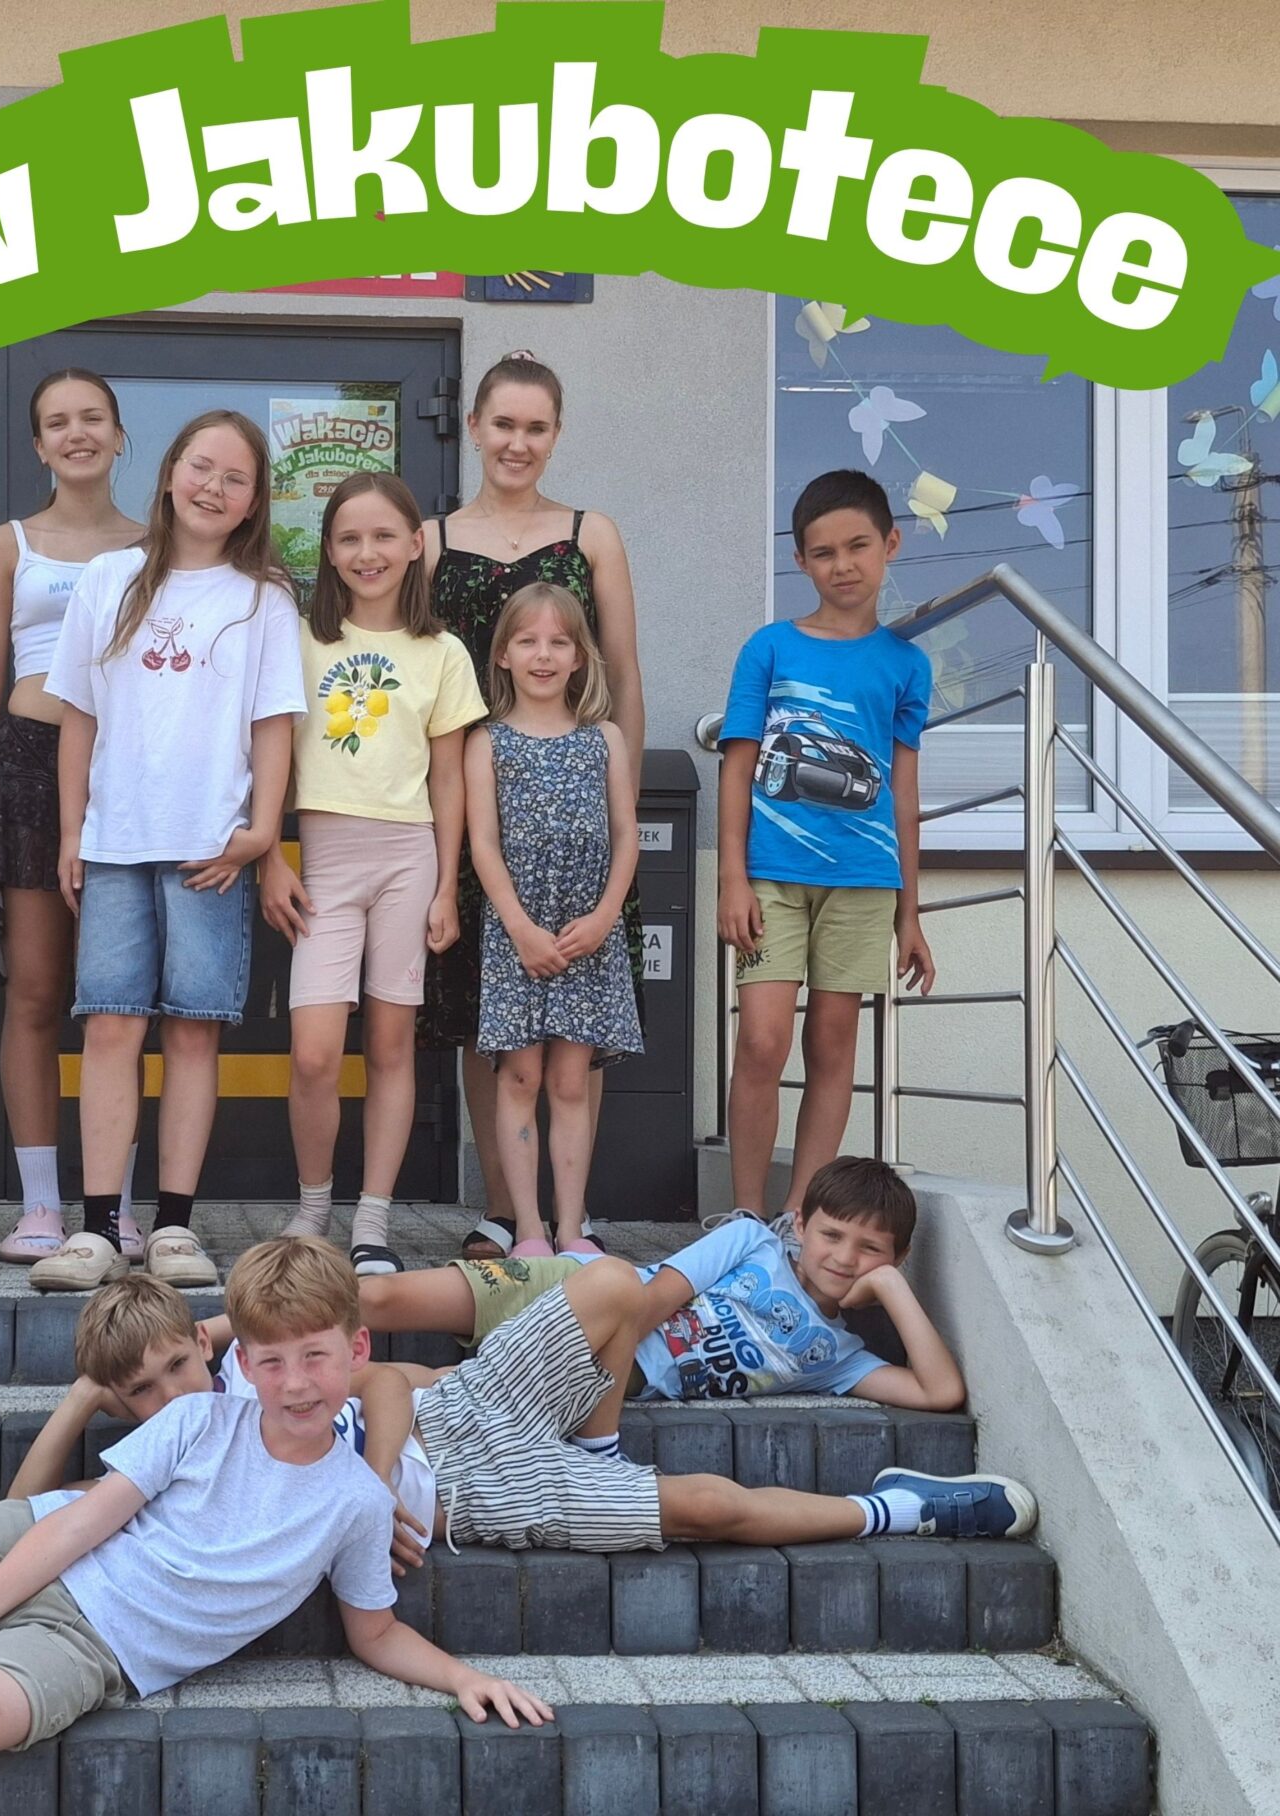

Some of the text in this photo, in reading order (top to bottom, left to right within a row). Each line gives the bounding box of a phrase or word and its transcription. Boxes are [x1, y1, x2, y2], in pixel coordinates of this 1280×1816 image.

[274, 415, 391, 449] Wakacje
[346, 652, 396, 673] LEMONS
[637, 827, 660, 842] ŻEK
[702, 1324, 749, 1398] PUPS
